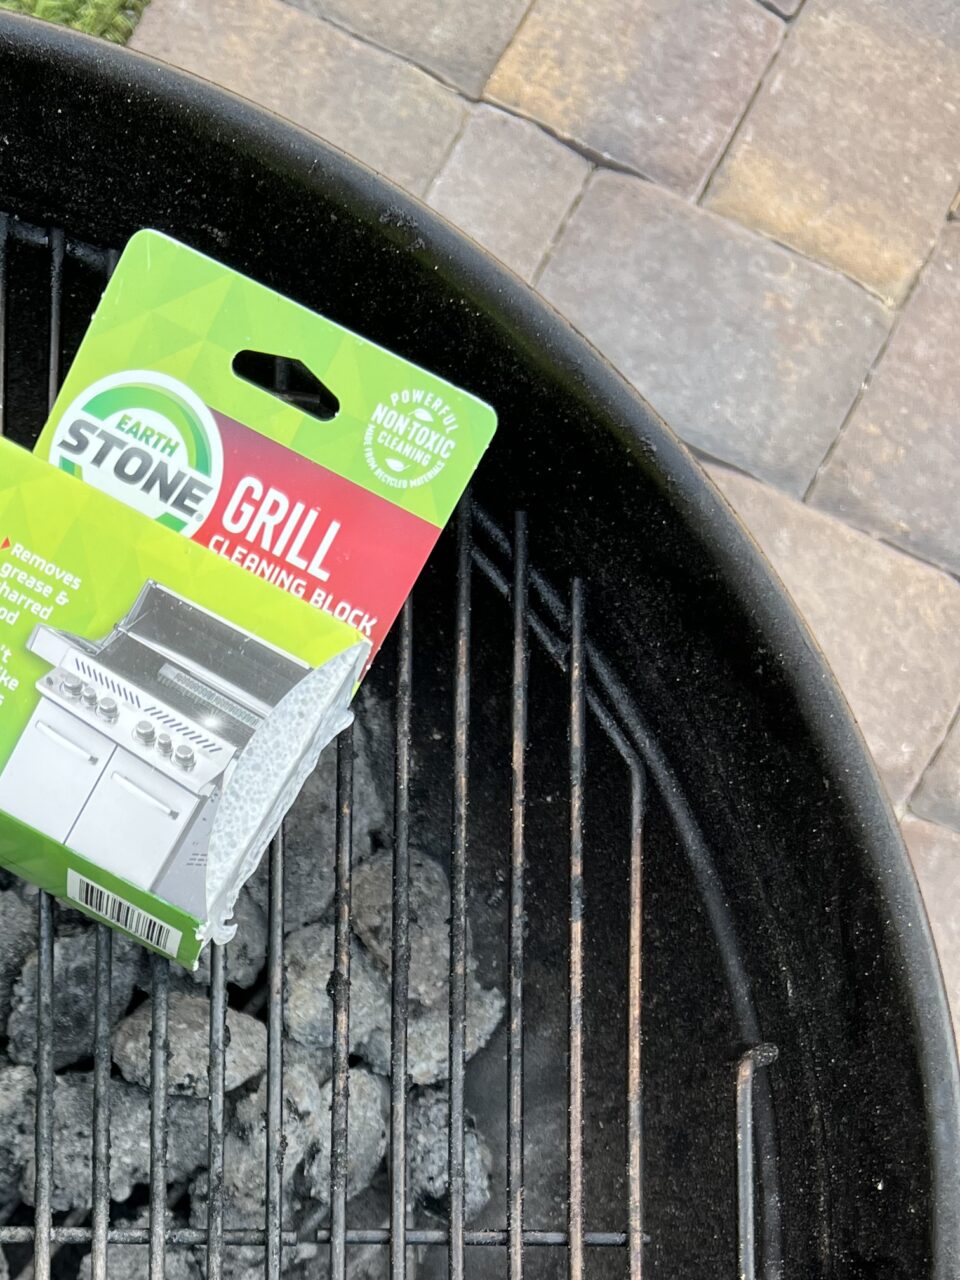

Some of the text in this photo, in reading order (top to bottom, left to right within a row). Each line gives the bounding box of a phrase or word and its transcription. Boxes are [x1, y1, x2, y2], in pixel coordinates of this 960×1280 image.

[371, 402, 456, 459] NON-TOXIC
[390, 389, 459, 434] POWERFUL
[115, 414, 180, 458] EARTH
[377, 431, 432, 467] CLEANING
[57, 419, 213, 518] STONE
[222, 476, 341, 582] GRILL
[0, 562, 69, 606] grease &
[10, 543, 82, 591] Removes
[208, 534, 378, 637] CLEANING BLOCK
